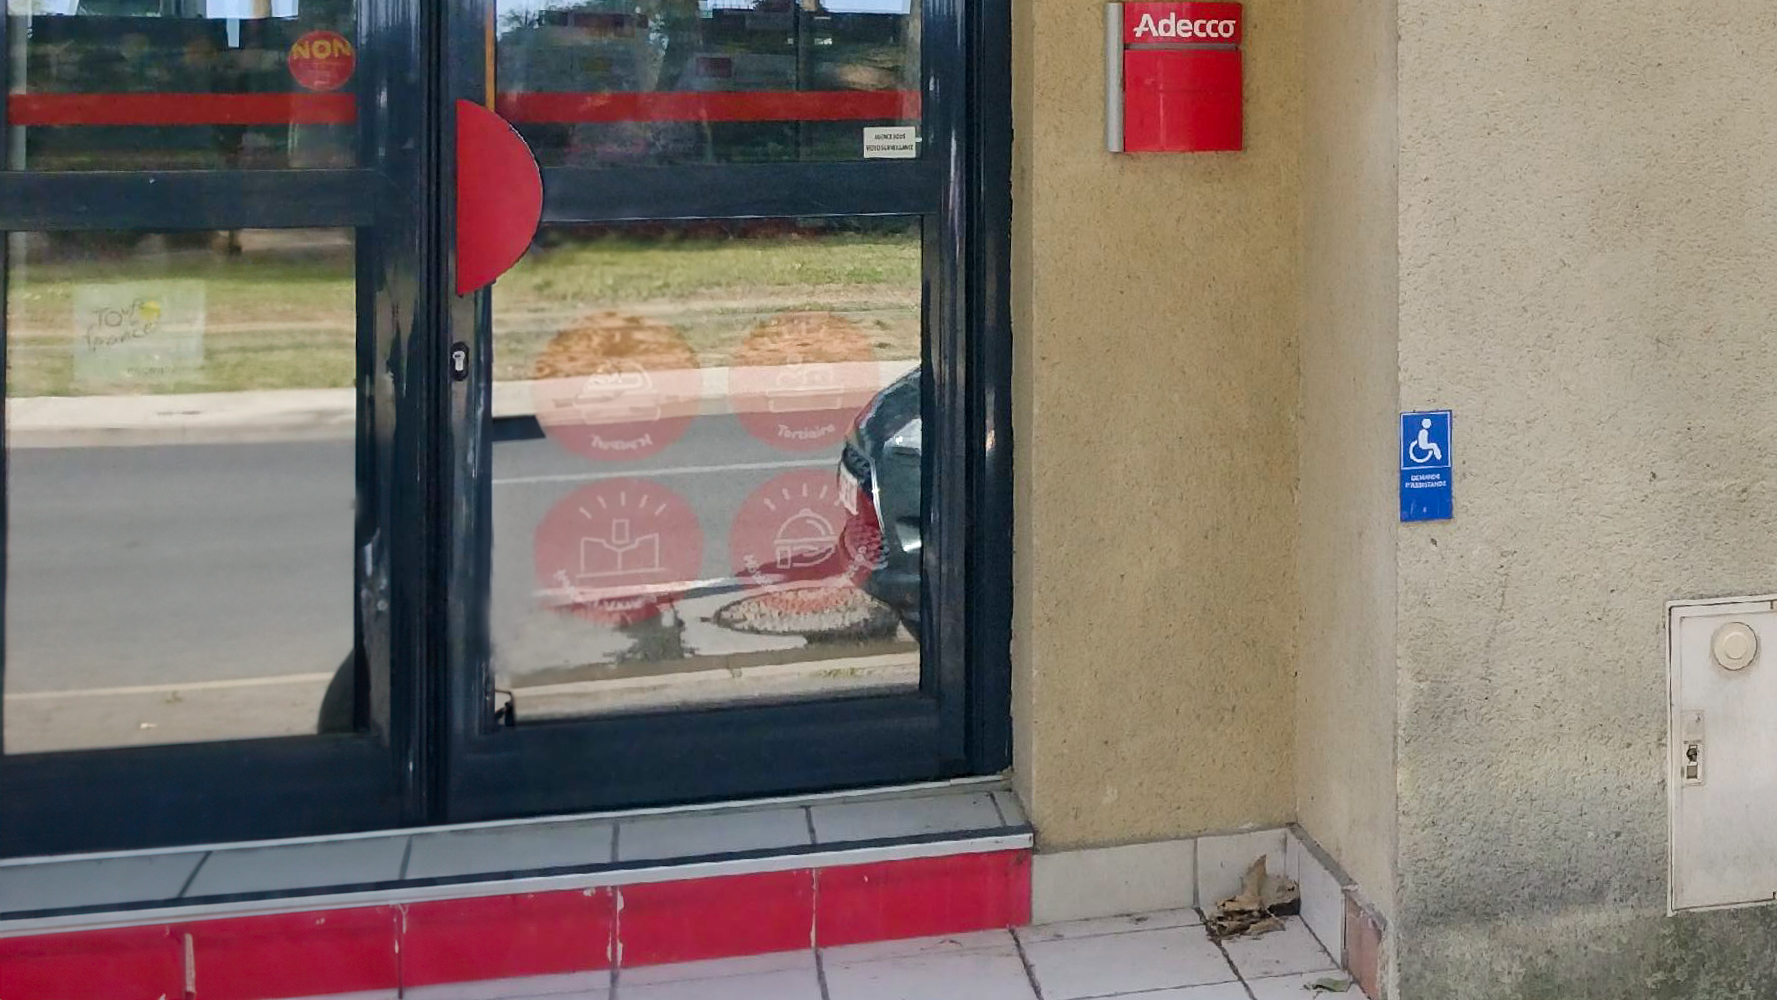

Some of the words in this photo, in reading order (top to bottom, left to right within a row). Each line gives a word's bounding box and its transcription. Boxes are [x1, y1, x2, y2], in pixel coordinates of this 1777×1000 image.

[1133, 12, 1237, 38] Adecco
[293, 39, 352, 60] NON
[777, 423, 836, 440] Tertiaire
